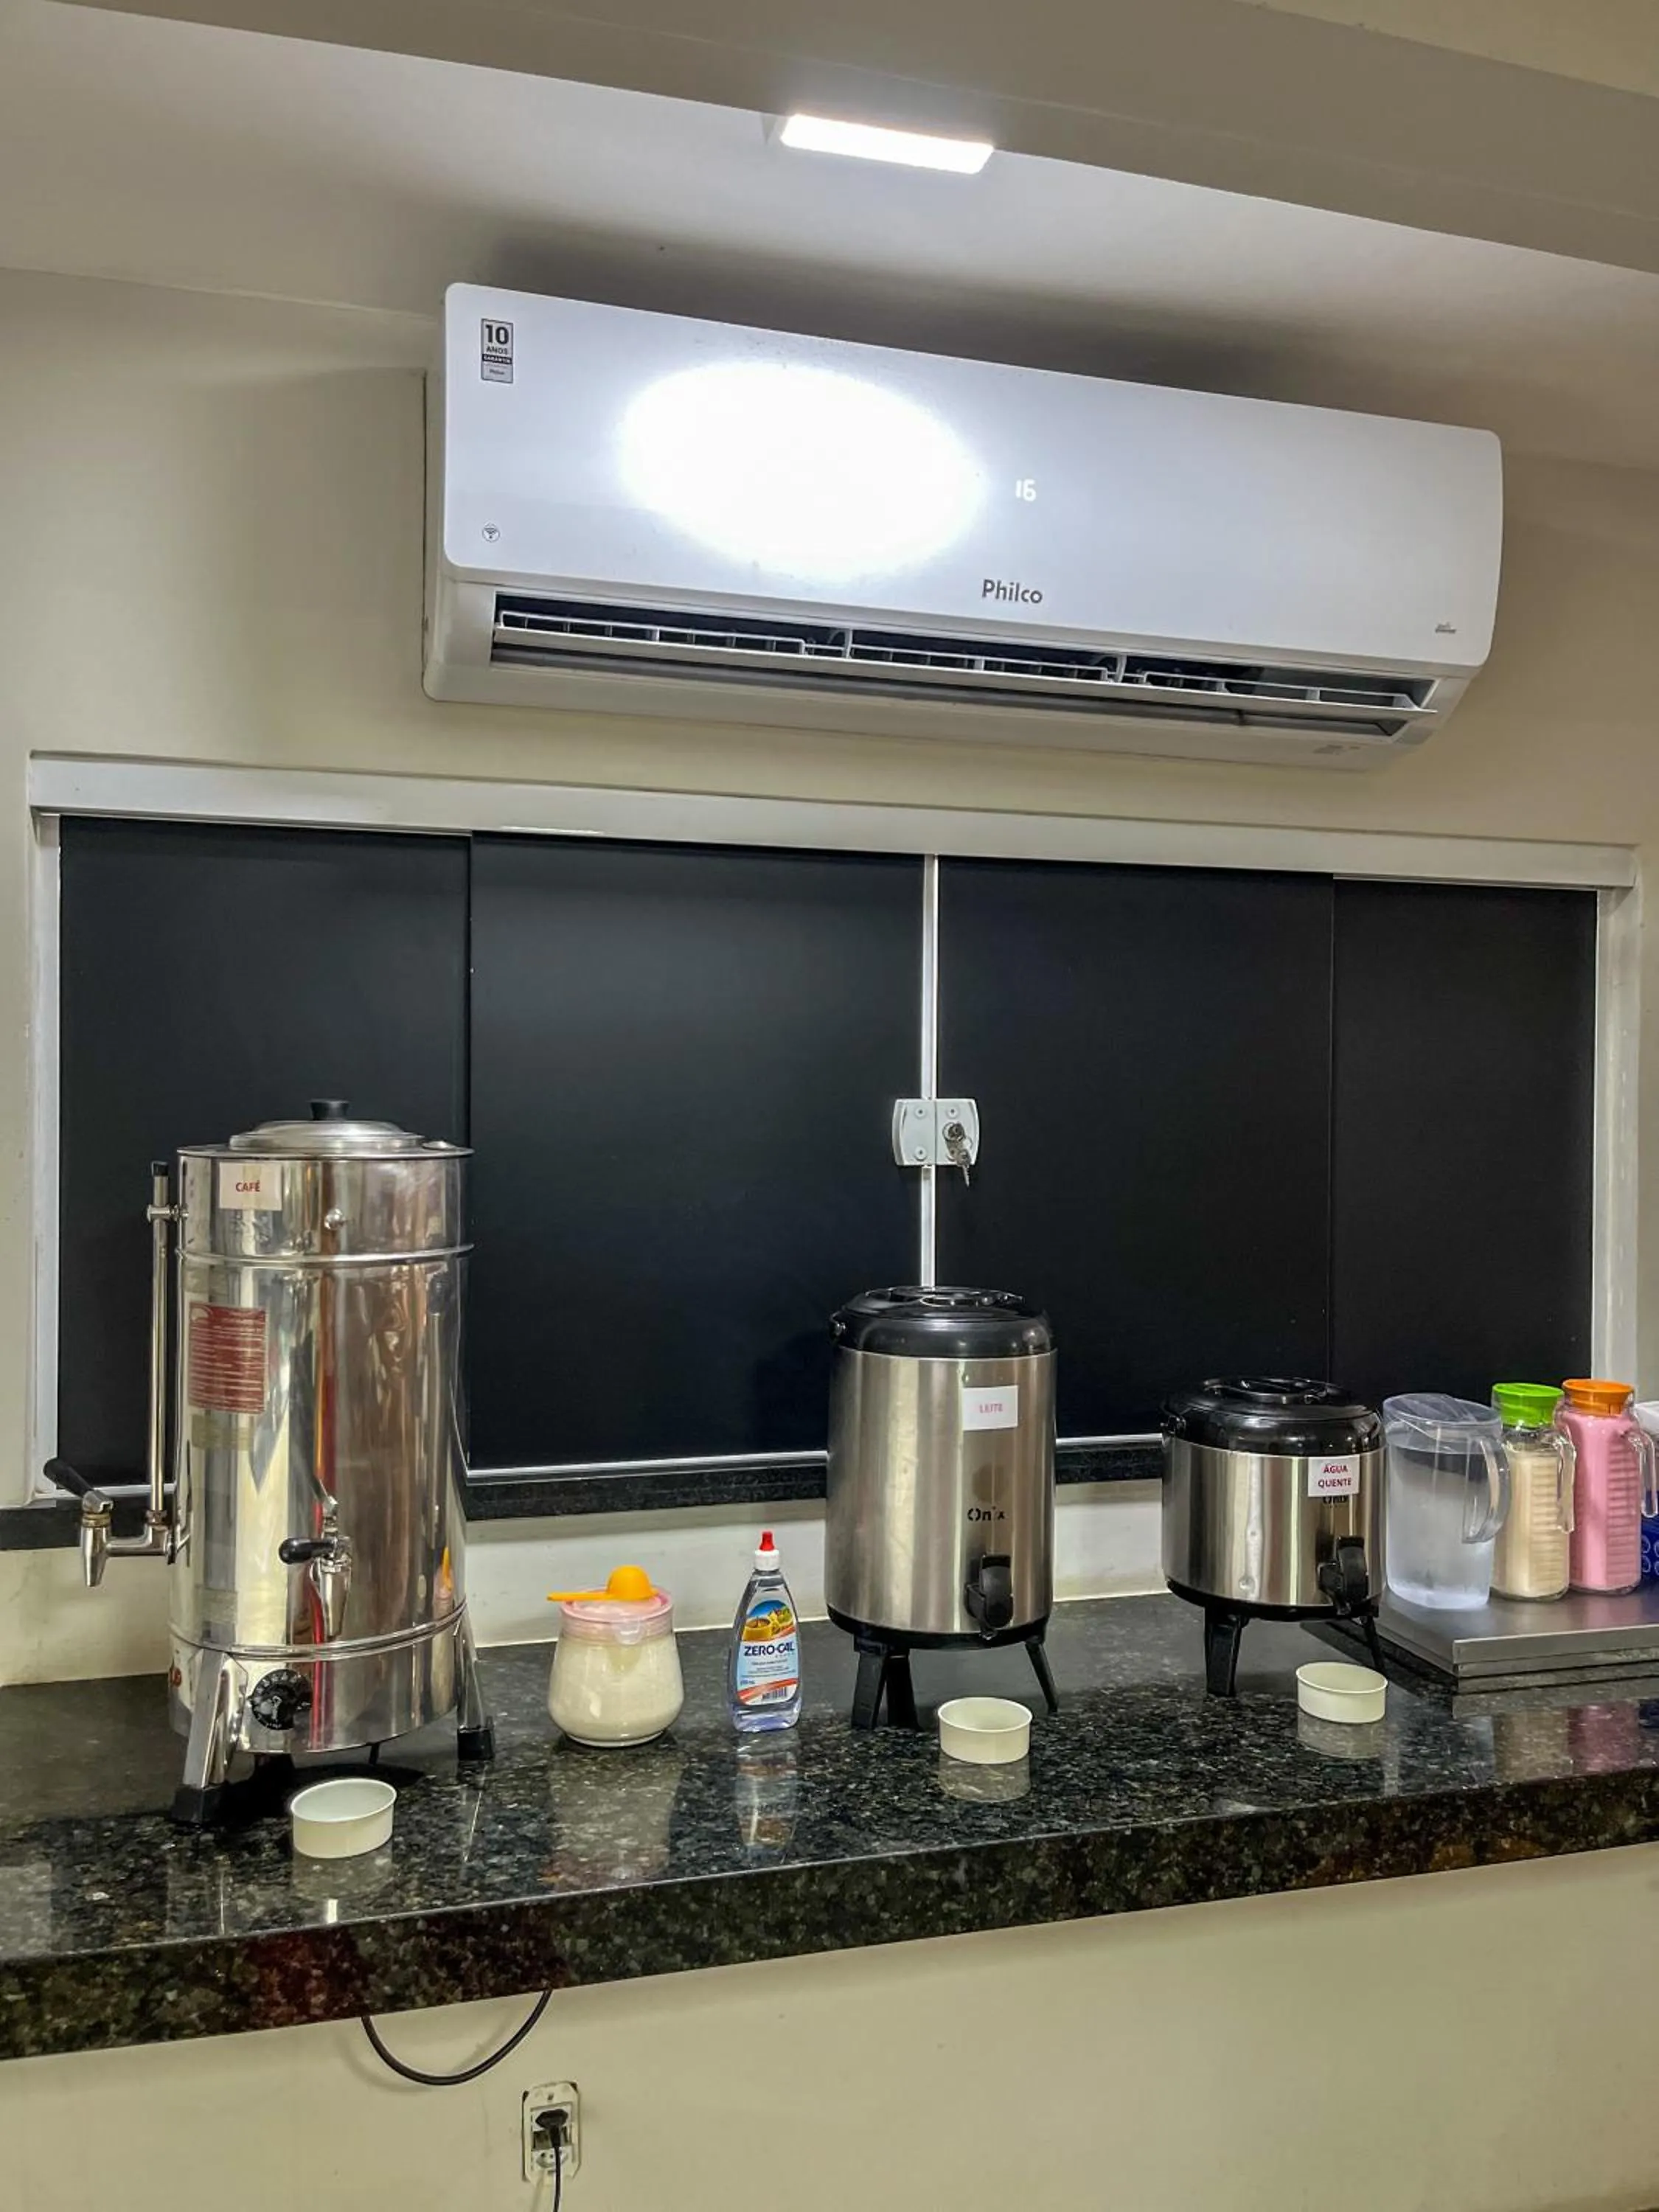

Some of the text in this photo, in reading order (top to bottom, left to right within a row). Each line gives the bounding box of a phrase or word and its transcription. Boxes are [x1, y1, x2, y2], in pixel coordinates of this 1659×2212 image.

[485, 324, 509, 345] 10
[1015, 479, 1037, 501] 16
[981, 579, 1043, 604] Philco
[235, 1180, 260, 1192] CAFÉ
[979, 1403, 1004, 1413] LEITE
[1318, 1478, 1352, 1488] QUENTE
[967, 1506, 1005, 1521] Onix
